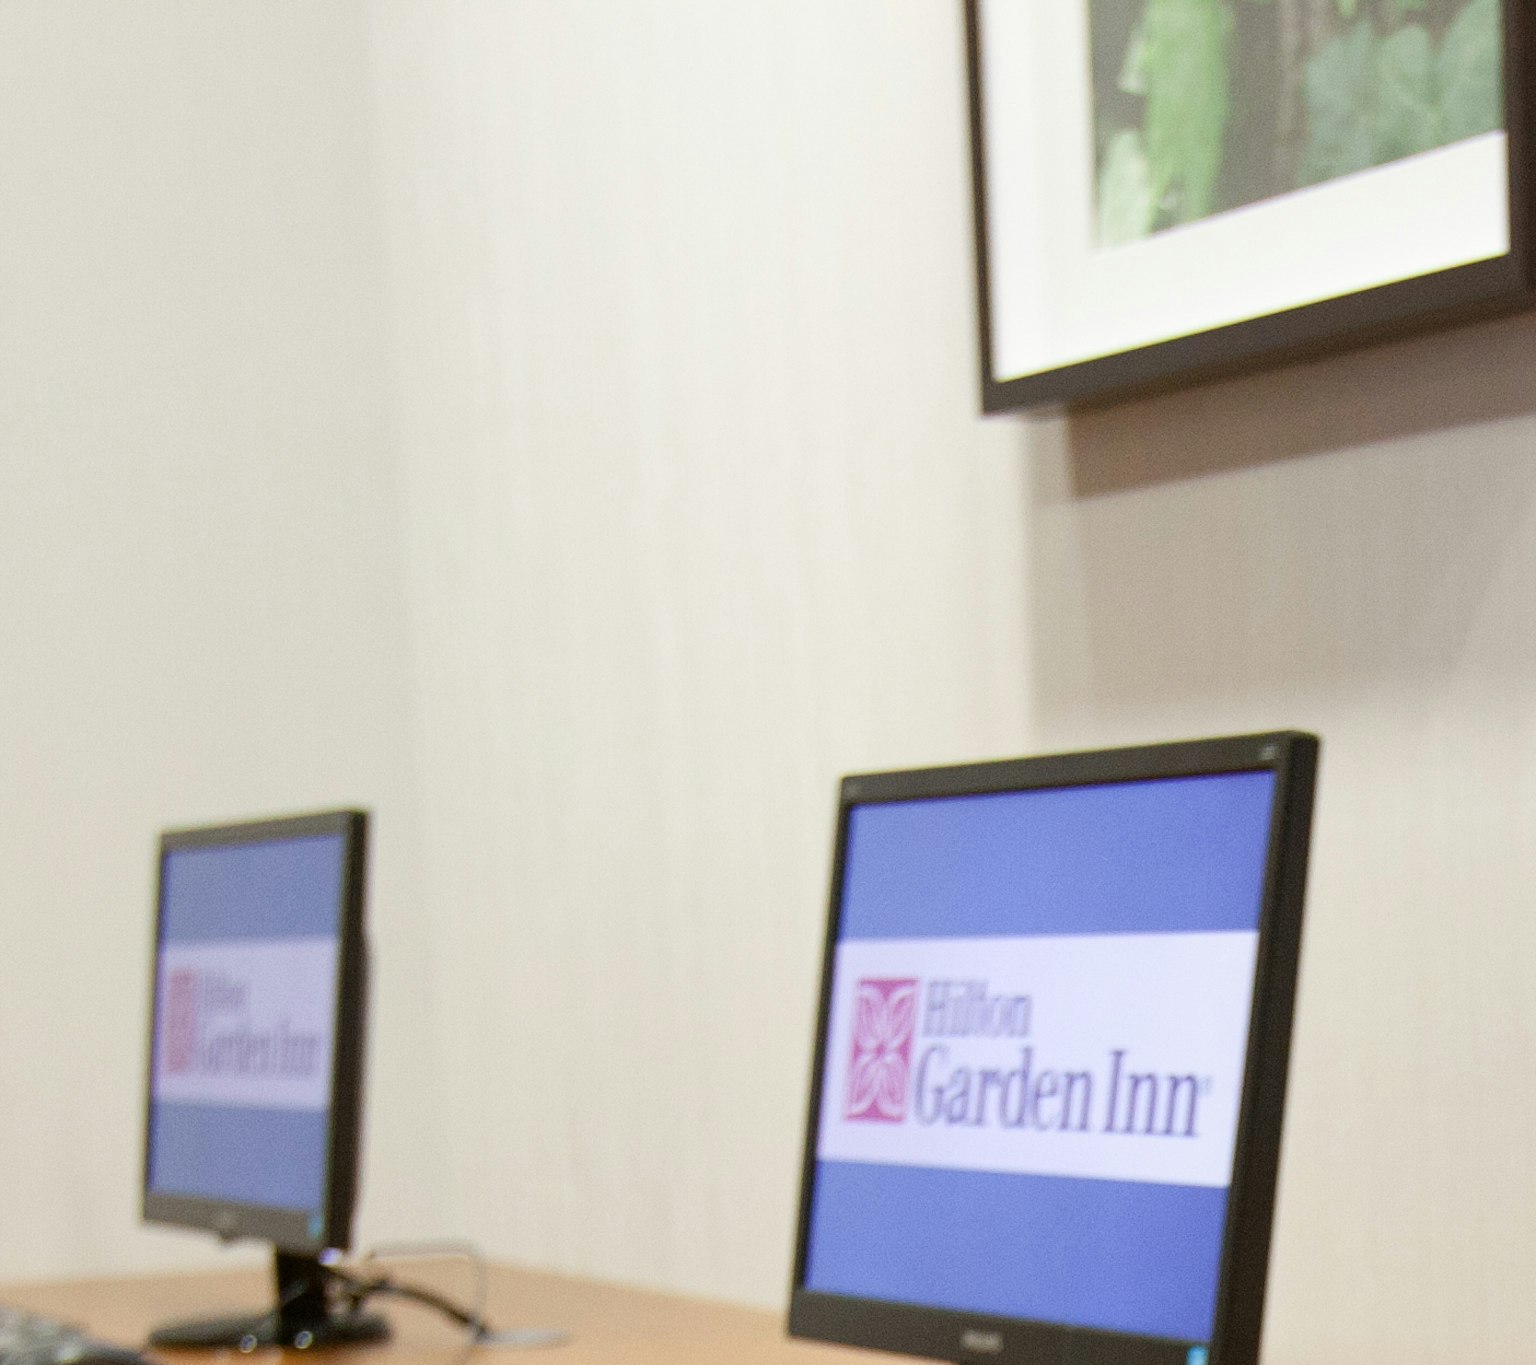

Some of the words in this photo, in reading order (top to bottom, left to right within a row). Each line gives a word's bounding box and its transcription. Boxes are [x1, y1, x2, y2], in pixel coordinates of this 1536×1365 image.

[923, 979, 1032, 1039] Hilton
[914, 1045, 1091, 1133] Garden
[1102, 1050, 1200, 1137] Inn
